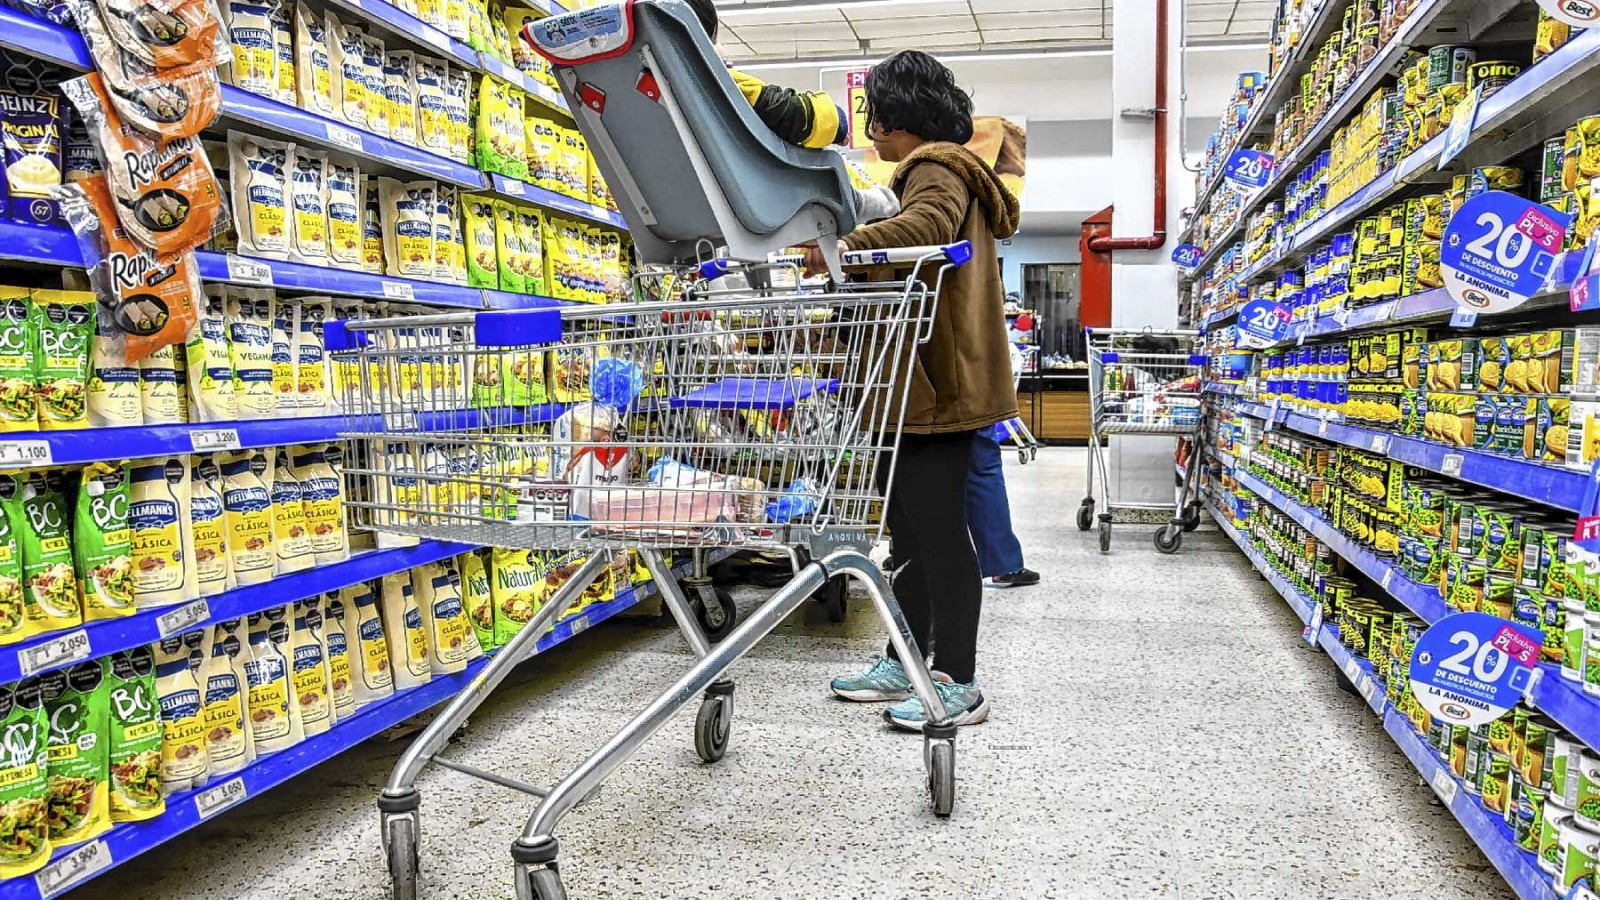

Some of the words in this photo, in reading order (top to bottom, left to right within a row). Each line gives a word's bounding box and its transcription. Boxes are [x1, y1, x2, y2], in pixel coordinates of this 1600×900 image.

[1566, 1, 1594, 17] Best
[1235, 156, 1263, 178] 20
[34, 203, 49, 214] 57
[1527, 210, 1560, 237] Exclusivo
[1465, 212, 1532, 268] 20
[1180, 248, 1195, 261] 20
[1462, 252, 1472, 262] DE
[1472, 257, 1519, 281] DESCUENTO
[1454, 271, 1465, 281] LA
[1466, 276, 1510, 299] ANONIMA
[1467, 292, 1485, 305] Best
[1249, 306, 1279, 331] 20
[41, 329, 81, 354] BC
[216, 432, 236, 443] 3.200
[18, 446, 47, 458] 1.100
[27, 501, 62, 534] BC
[92, 494, 129, 527] BC
[305, 506, 338, 519] CLÁSICA
[234, 520, 269, 532] CLÁSICA
[186, 602, 207, 619] 5.050
[60, 634, 87, 654] 2.050
[1502, 628, 1535, 653] Exclusivo
[1438, 631, 1509, 683] 20
[1435, 669, 1448, 679] DE
[1448, 673, 1498, 694] DESCUENTO
[111, 685, 152, 720] BC
[1428, 686, 1441, 697] LA
[1442, 691, 1490, 712] ANONIMA
[1446, 705, 1466, 718] Best
[164, 725, 205, 742] CLÁSICA
[222, 781, 243, 798] 5.050
